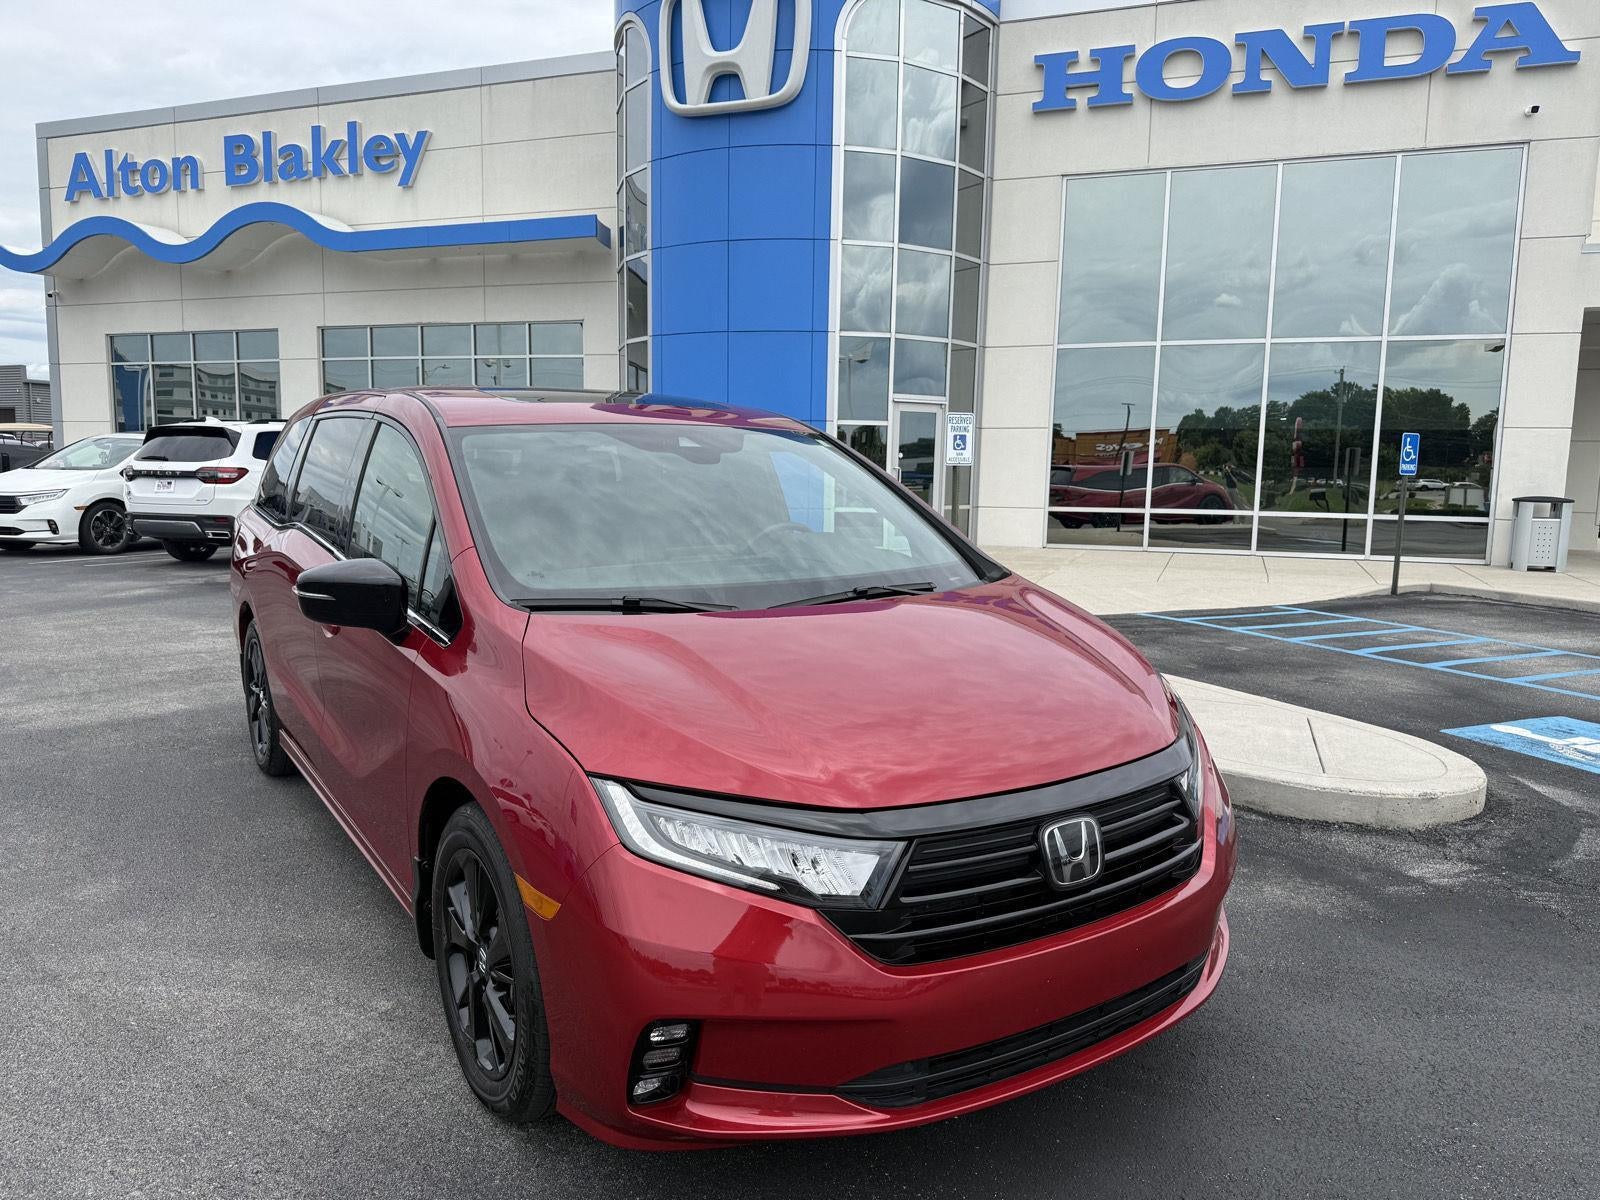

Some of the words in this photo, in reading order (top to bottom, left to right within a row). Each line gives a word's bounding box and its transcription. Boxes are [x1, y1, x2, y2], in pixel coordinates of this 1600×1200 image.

[1032, 1, 1581, 112] HONDA
[65, 149, 204, 202] Alton
[223, 120, 432, 188] Blakley
[948, 416, 972, 425] RESERVED
[950, 425, 970, 433] PARKING
[1401, 463, 1416, 471] PARKING
